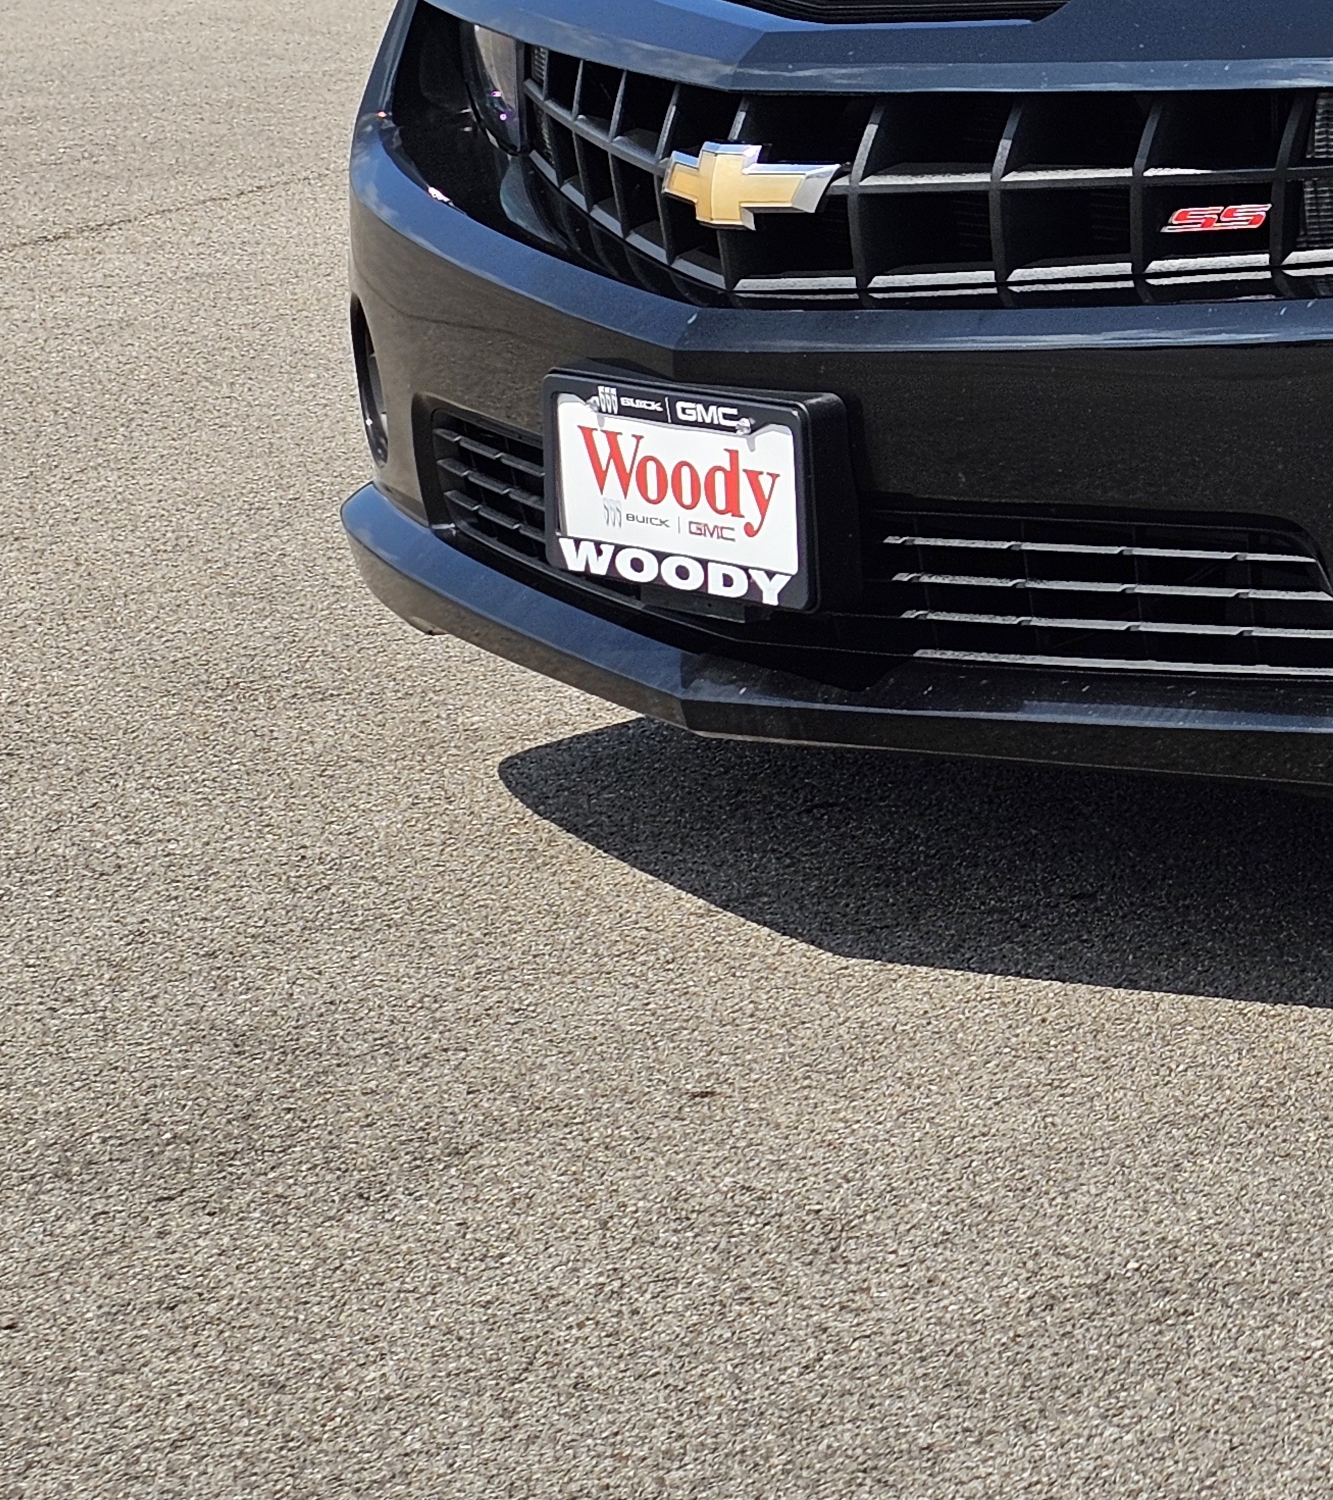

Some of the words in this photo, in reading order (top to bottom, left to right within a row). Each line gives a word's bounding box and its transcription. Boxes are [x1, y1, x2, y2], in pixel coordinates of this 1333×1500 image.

[1159, 203, 1273, 233] SS
[620, 396, 664, 412] BUICK
[675, 401, 740, 427] GMC
[577, 425, 780, 537] Woody
[625, 513, 670, 528] BUICK
[688, 520, 736, 542] GMC
[558, 537, 794, 606] WOODY
